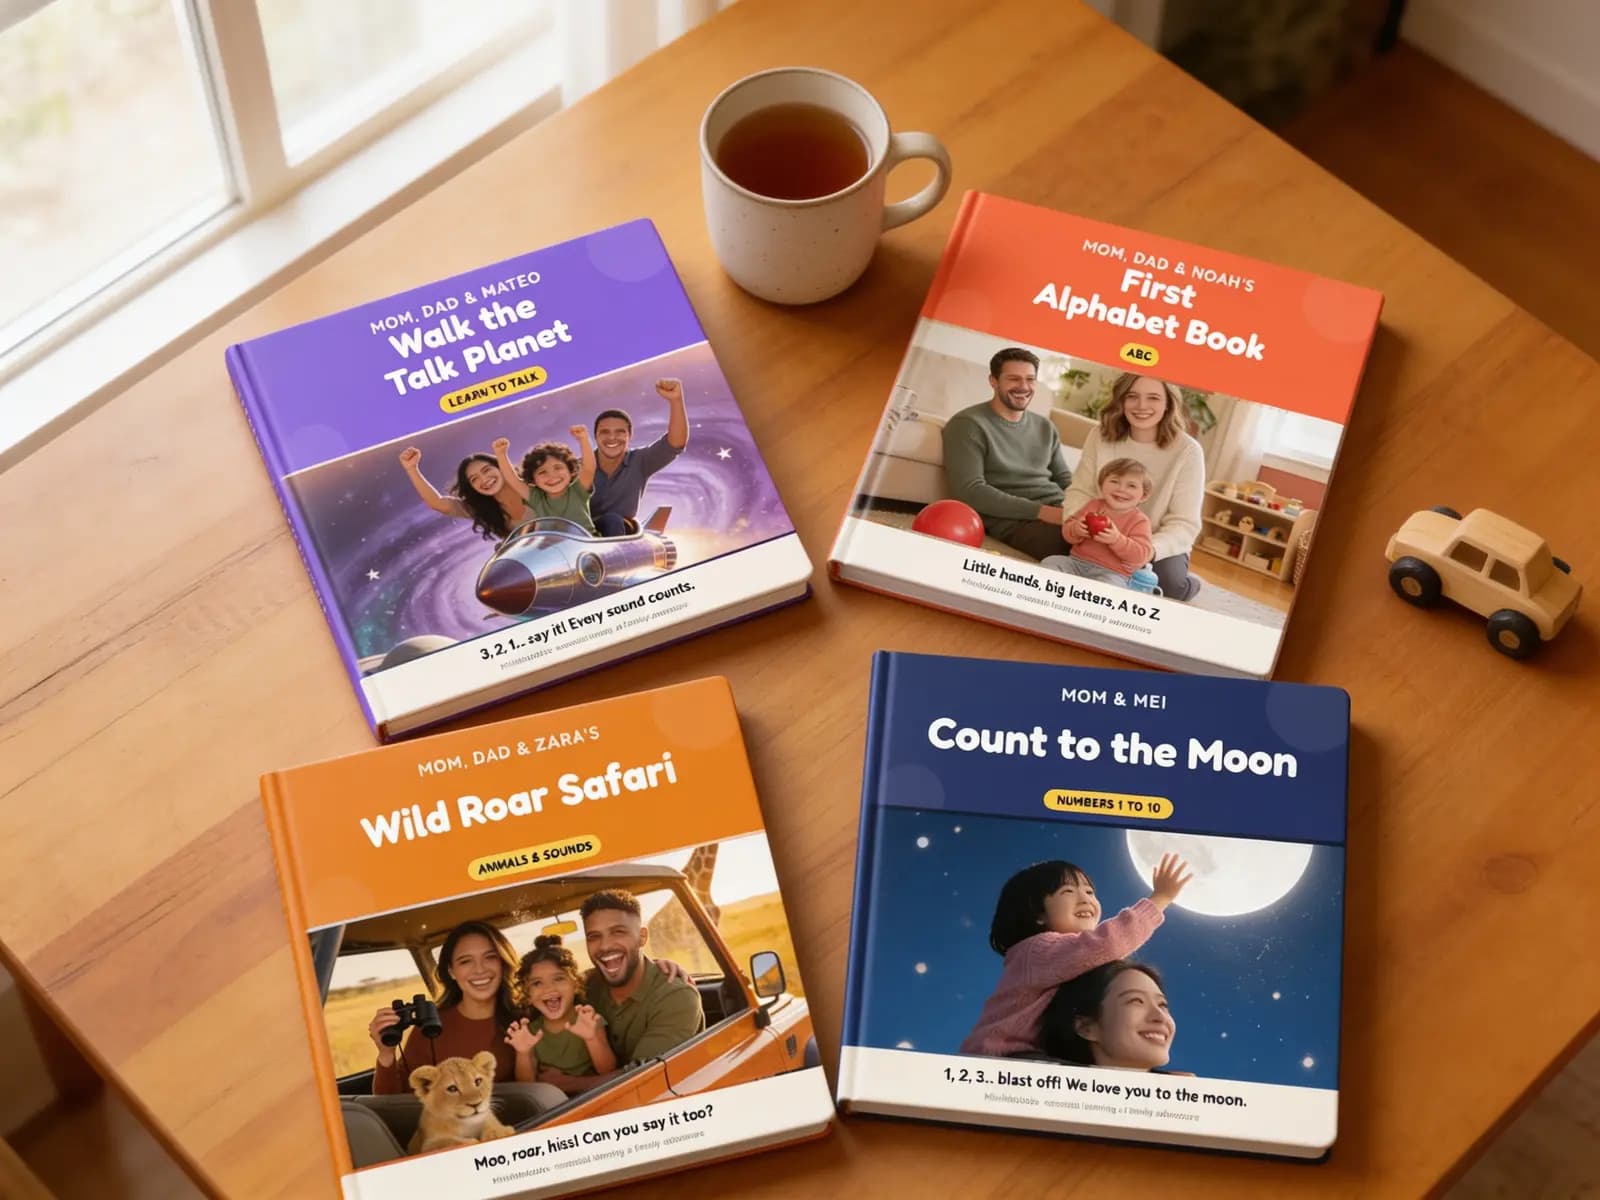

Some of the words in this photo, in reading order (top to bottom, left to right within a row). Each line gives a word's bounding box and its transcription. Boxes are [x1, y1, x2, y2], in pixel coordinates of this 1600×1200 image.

[1121, 269, 1196, 308] First
[1134, 252, 1168, 270] DAD
[1175, 262, 1185, 275] &
[1192, 267, 1255, 292] NOAH'S
[422, 298, 459, 318] DAD
[465, 292, 477, 304] &
[482, 272, 540, 298] MATEO
[388, 315, 475, 358] Walk
[479, 300, 536, 330] the
[1033, 283, 1180, 339] Alphabet
[1185, 320, 1265, 360] Book
[384, 356, 459, 396] Talk
[463, 320, 572, 373] Planet
[1127, 349, 1152, 361] ABC
[448, 387, 488, 407] LEARN
[491, 383, 507, 394] TO
[509, 372, 539, 388] TALK
[963, 559, 997, 577] Little
[1000, 568, 1040, 590] hands,
[1045, 580, 1065, 597] big
[1070, 586, 1115, 610] letters,
[1118, 600, 1128, 611] A
[1133, 605, 1146, 616] to
[528, 630, 549, 646] say
[568, 610, 603, 630] Every
[607, 596, 645, 617] sound
[649, 583, 695, 603] counts.
[1061, 688, 1107, 705] MOM
[1114, 692, 1126, 706] &
[1133, 694, 1166, 709] MEI
[473, 747, 510, 765] DAD
[517, 741, 530, 756] &
[535, 726, 599, 751] ZARA'S
[928, 717, 1048, 757] Count
[1057, 730, 1100, 761] to
[1111, 732, 1177, 768] the
[1188, 739, 1298, 778] Moon
[360, 801, 451, 848] Wild
[457, 787, 548, 827] Roar
[558, 752, 677, 805] Safari
[1056, 796, 1114, 809] NUMBERS
[1118, 801, 1123, 809] 1
[1127, 801, 1143, 812] TO
[1148, 803, 1160, 813] 10
[532, 852, 540, 863] &
[544, 841, 592, 860] SOUNDS
[998, 1071, 1032, 1087] blast
[1066, 1077, 1087, 1092] We
[1092, 1080, 1121, 1095] love
[1124, 1086, 1151, 1099] you
[1155, 1086, 1171, 1100] to
[1175, 1089, 1198, 1102] the
[1203, 1094, 1247, 1107] moon.
[474, 1156, 509, 1171] Moo,
[512, 1145, 545, 1161] roar,
[583, 1131, 610, 1145] Can
[613, 1124, 639, 1142] you
[643, 1117, 665, 1131] say
[669, 1113, 679, 1126] it
[683, 1105, 713, 1122] too?
